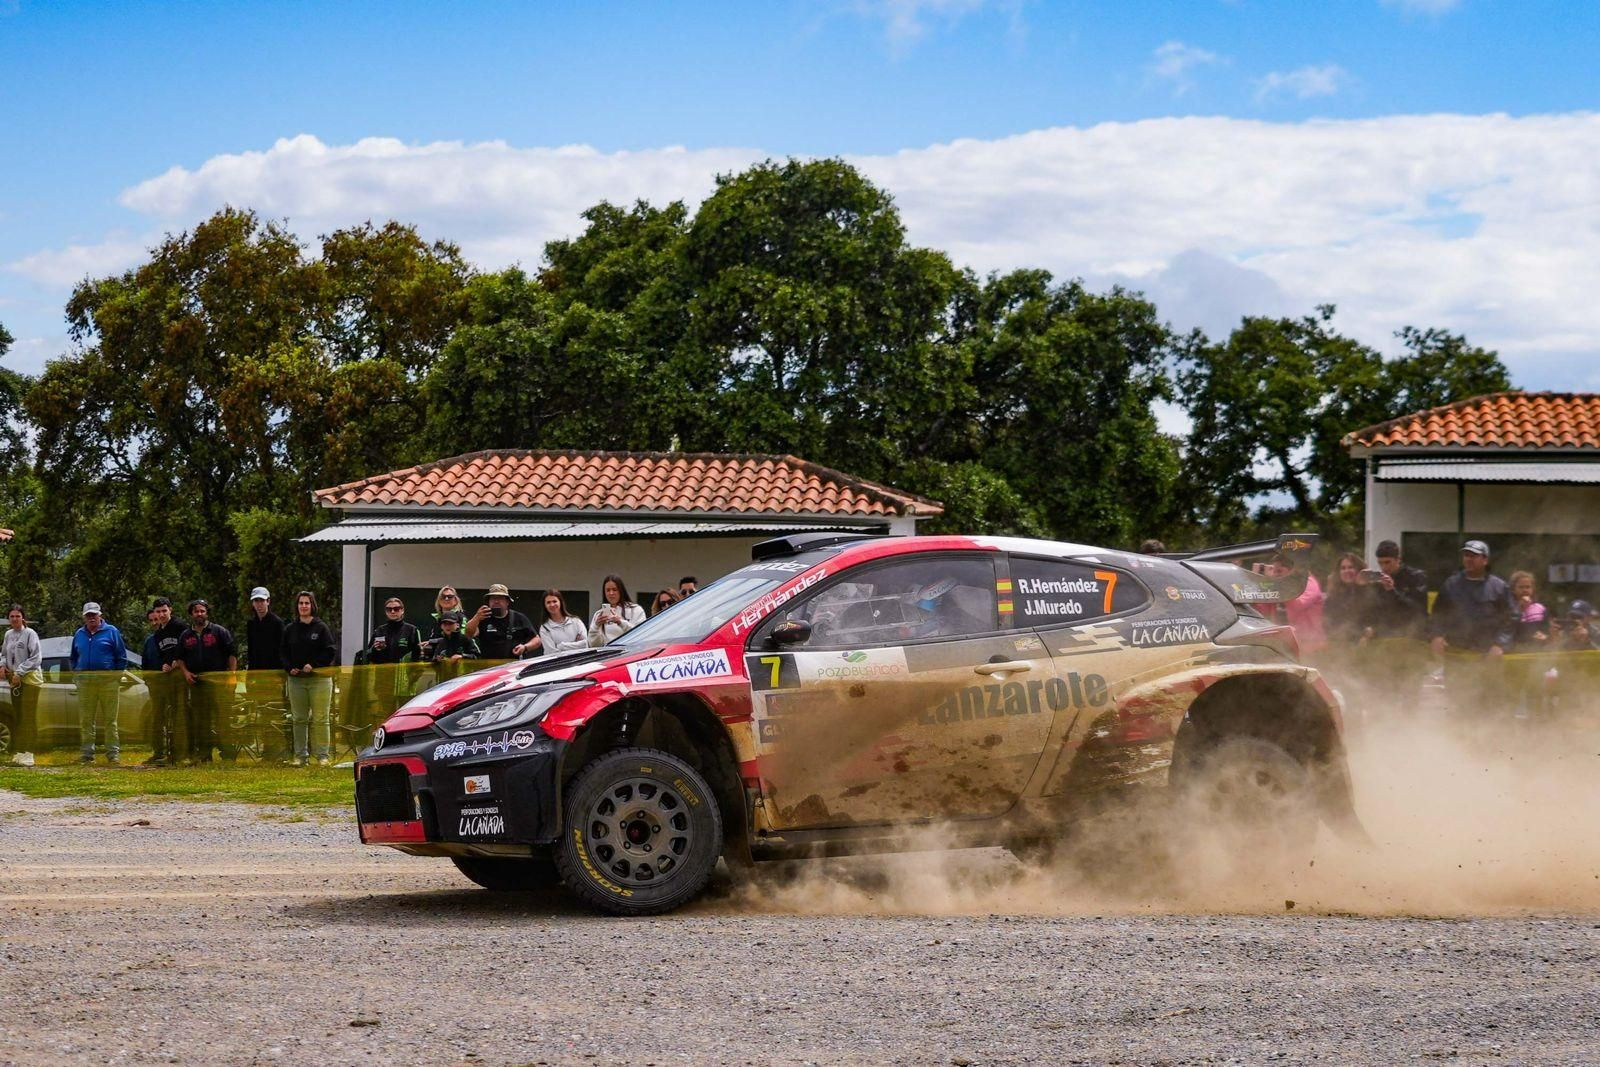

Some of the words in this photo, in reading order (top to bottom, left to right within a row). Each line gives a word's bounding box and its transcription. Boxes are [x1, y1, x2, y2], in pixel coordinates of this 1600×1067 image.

[1017, 577, 1100, 594] R.Hernández
[1094, 570, 1118, 614] 7
[731, 568, 828, 636] Hernández
[1024, 599, 1083, 616] J.Murado
[1131, 618, 1171, 628] PERFORACIONES
[1175, 616, 1198, 625] SONDEOS
[1132, 628, 1151, 645] LA
[1152, 624, 1210, 644] CAÑADA
[637, 656, 682, 667] PERFORACIONES
[688, 652, 714, 660] SONDEOS
[635, 668, 657, 683] LA
[660, 658, 727, 680] CAÑADA
[760, 656, 781, 688] 7
[817, 664, 901, 678] POZOBLANCO
[458, 817, 471, 836] LA
[471, 815, 505, 836] CAÑADA
[574, 828, 634, 897] SCORPION
